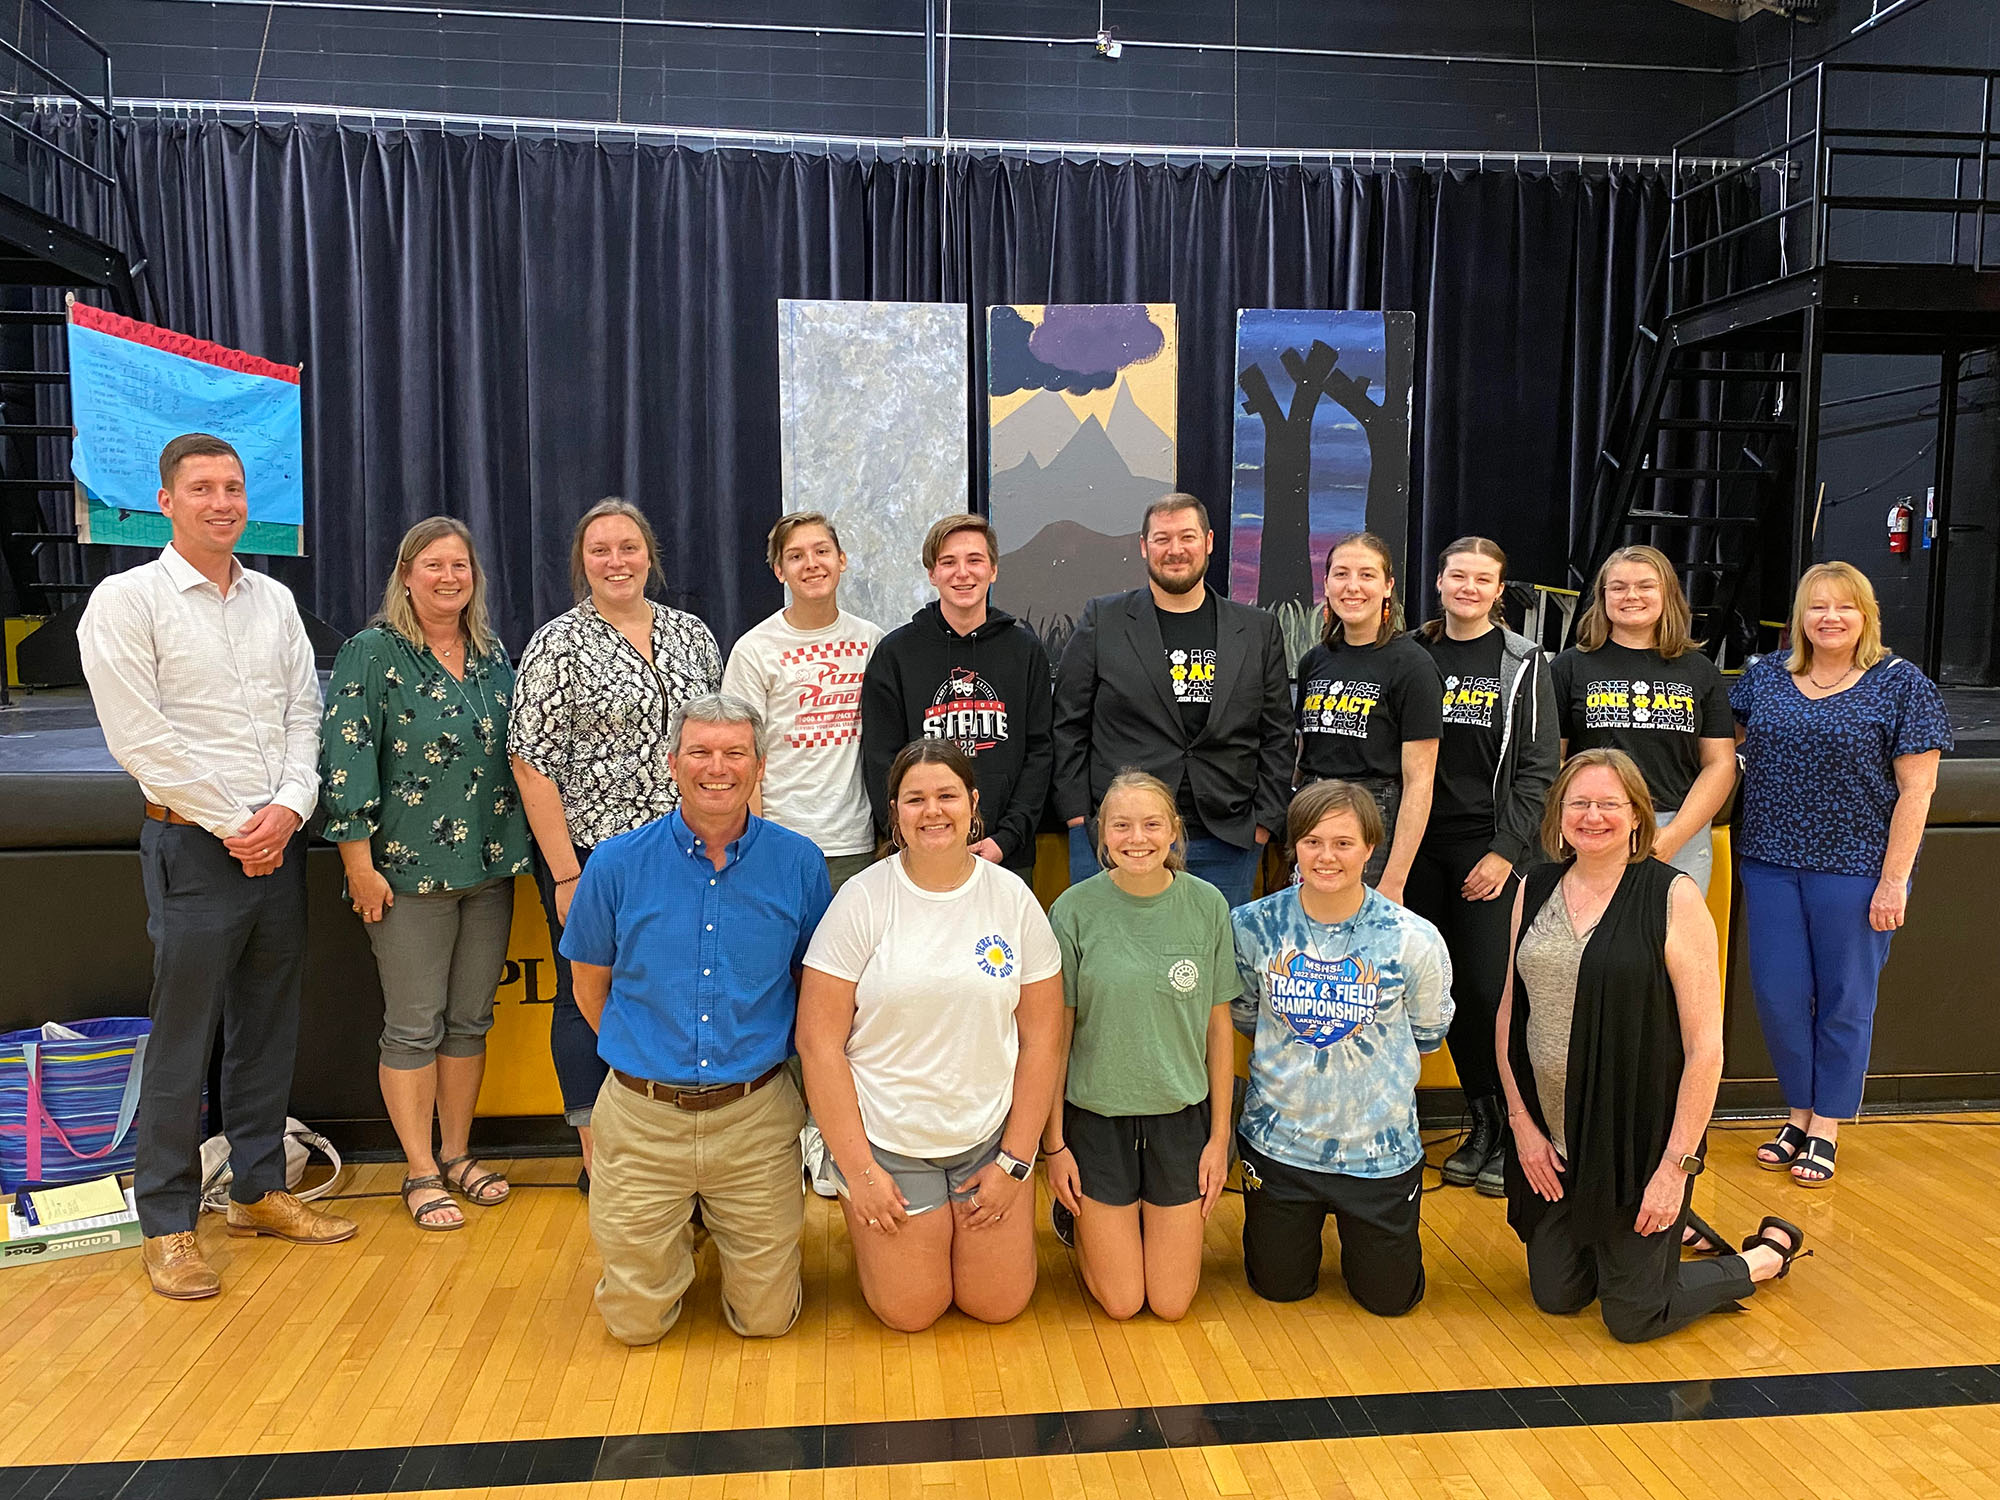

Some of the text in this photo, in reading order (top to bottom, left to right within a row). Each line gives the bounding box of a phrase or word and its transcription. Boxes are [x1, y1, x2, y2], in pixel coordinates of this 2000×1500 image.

[1188, 664, 1215, 680] AC
[1304, 694, 1377, 716] NE ACT
[1455, 689, 1499, 708] ACT
[1586, 693, 1695, 712] ONE ACT
[928, 702, 1002, 716] MINEOTA
[923, 709, 1008, 742] STATE
[975, 935, 1014, 960] HERE COMES
[977, 958, 1013, 978] THE SUN
[1304, 960, 1344, 973] MSHSL
[1310, 972, 1339, 982] SECTION
[1340, 975, 1353, 983] 1AA
[1269, 972, 1378, 1007] TRACK & FIELD
[1270, 995, 1376, 1026] CHAMPIONSHIPS
[4, 1229, 121, 1257] LEADING EDGE
